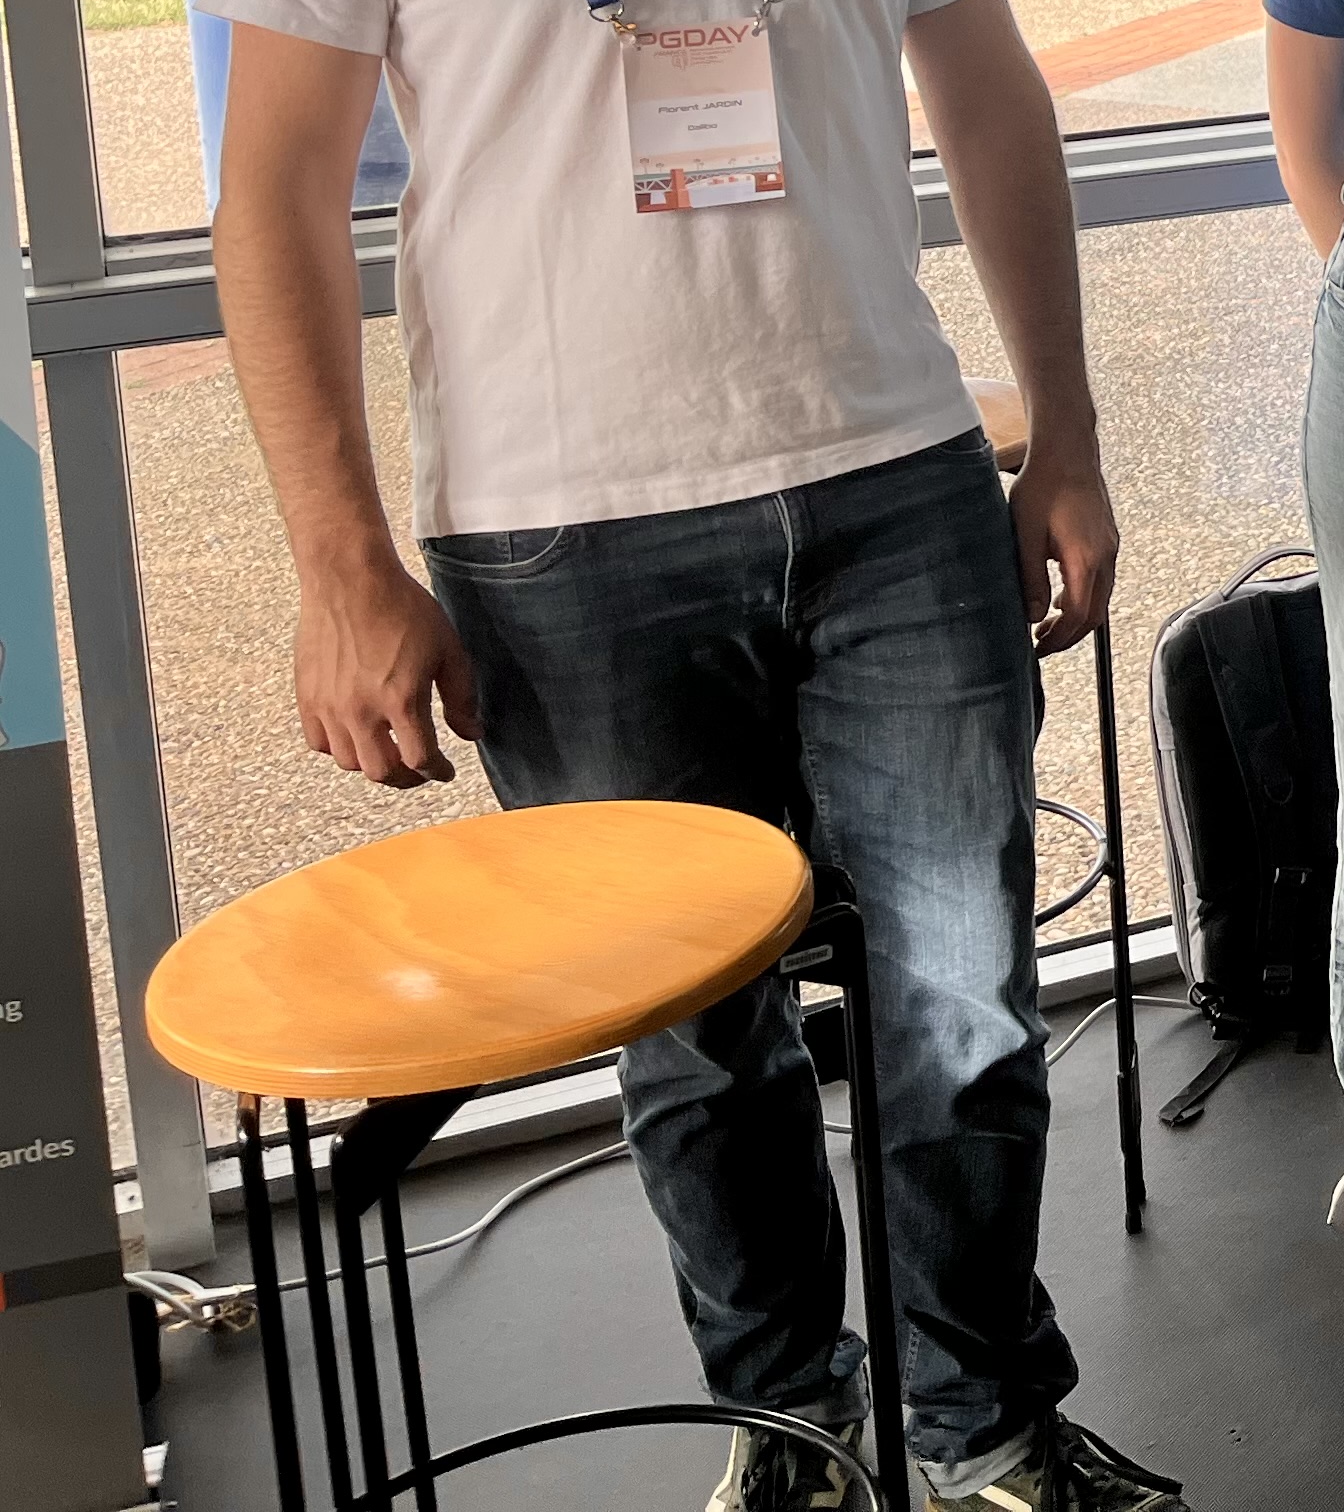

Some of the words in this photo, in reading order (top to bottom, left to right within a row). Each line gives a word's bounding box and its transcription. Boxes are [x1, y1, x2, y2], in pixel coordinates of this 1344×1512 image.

[637, 24, 750, 50] PGDAY
[658, 103, 699, 114] Florent
[701, 99, 743, 111] JARDIN
